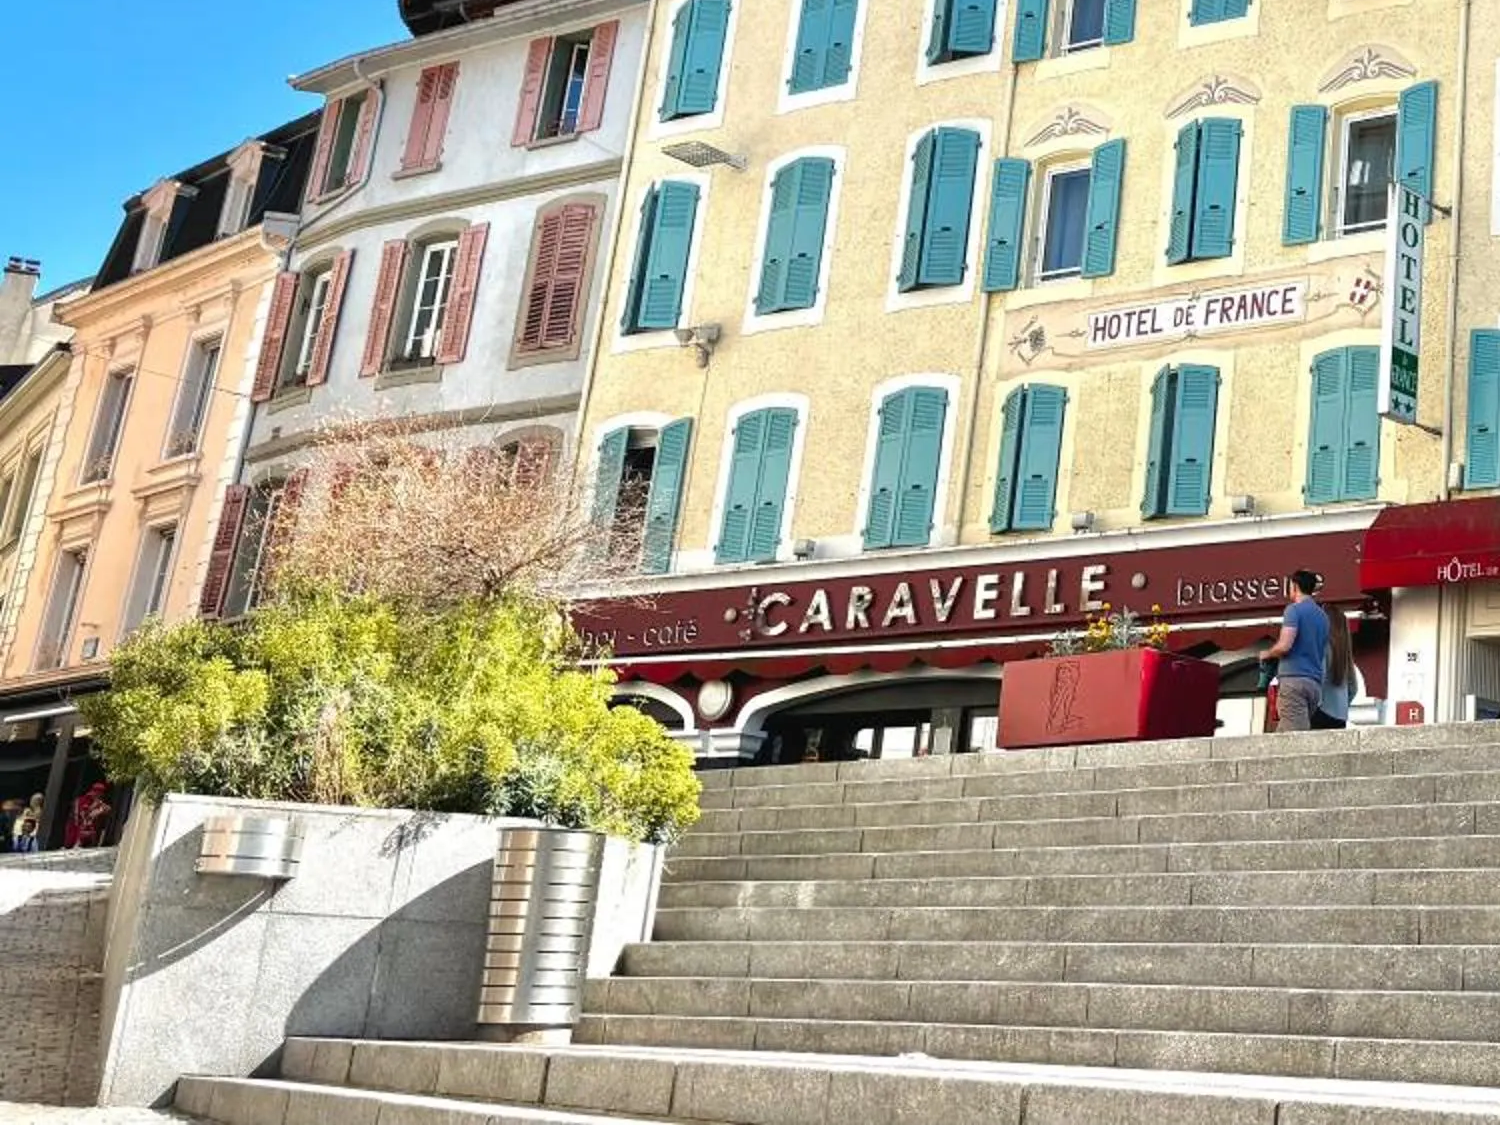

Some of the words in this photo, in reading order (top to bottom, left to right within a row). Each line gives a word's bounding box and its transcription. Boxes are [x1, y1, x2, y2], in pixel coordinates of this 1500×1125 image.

[1398, 190, 1421, 347] HOTEL
[1092, 306, 1163, 343] HOTEL
[1173, 304, 1197, 327] DE
[1203, 286, 1298, 326] FRANCE
[1437, 556, 1484, 582] HÔTEL
[756, 564, 1108, 637] CARAVELLE
[643, 618, 697, 646] café
[1408, 707, 1420, 722] H
